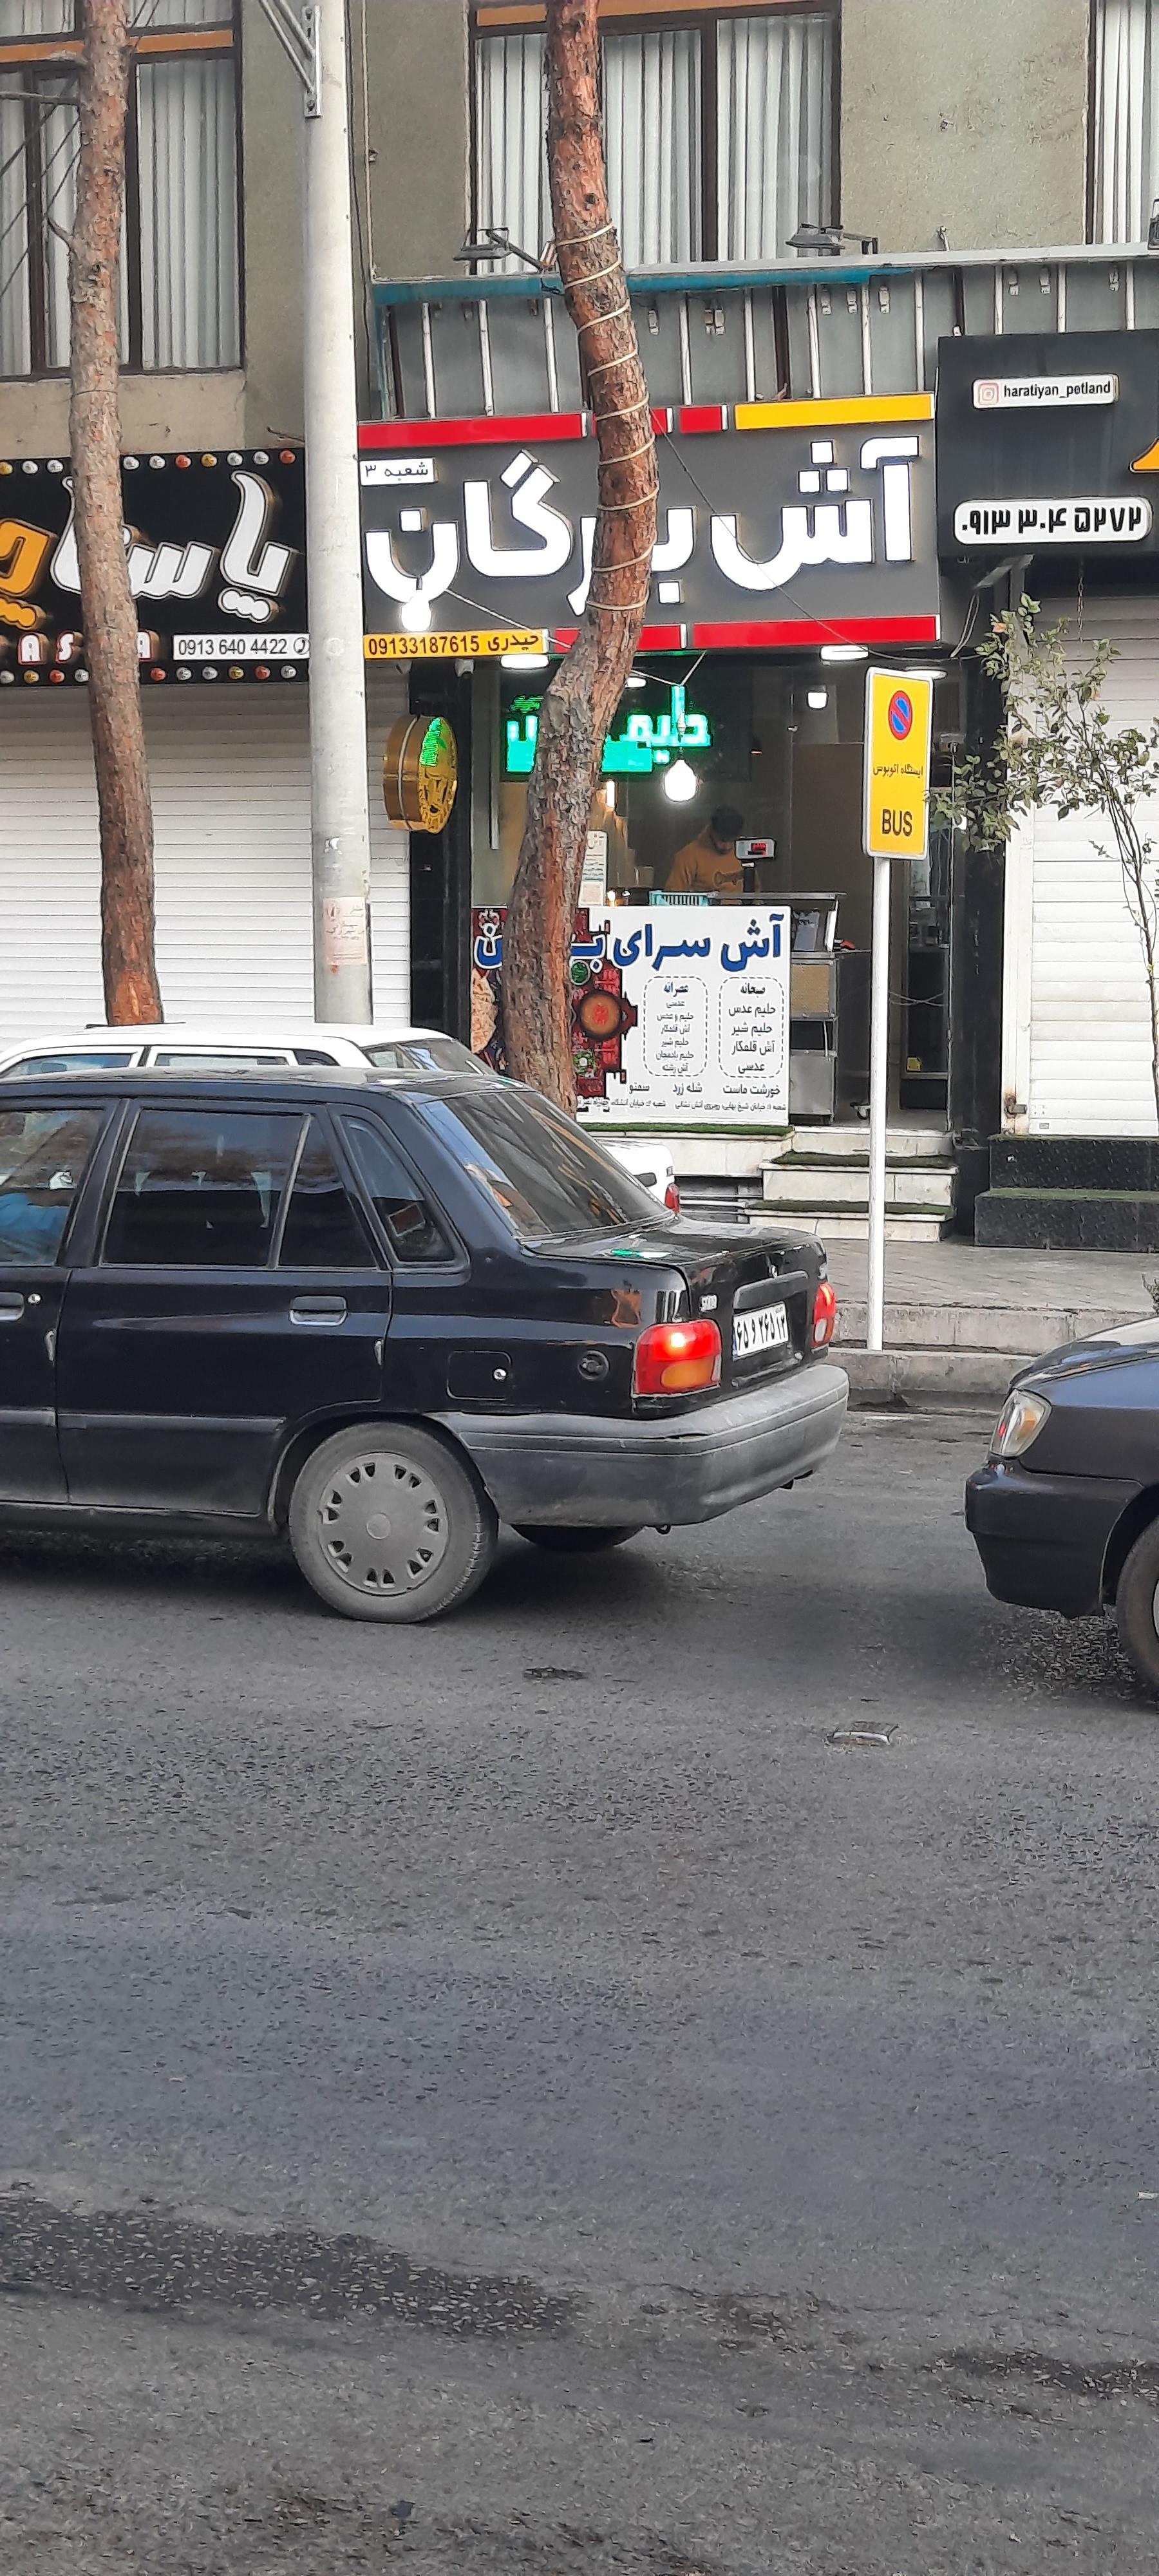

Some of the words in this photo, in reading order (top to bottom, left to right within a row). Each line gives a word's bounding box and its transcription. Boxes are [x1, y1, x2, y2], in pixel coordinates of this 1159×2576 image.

[364, 464, 377, 478] ۳
[384, 462, 429, 481] شعبه
[710, 435, 919, 591] آش
[365, 450, 694, 616] برگان
[178, 638, 214, 656] 0913
[218, 638, 246, 655] 640
[250, 637, 288, 655] 4422
[368, 635, 480, 656] 09133187615
[487, 634, 540, 651] حیدری
[619, 685, 711, 765] حلیم
[872, 762, 899, 778] اتوبوس
[881, 809, 912, 837] BUS
[613, 923, 711, 971] سرای
[720, 913, 784, 972] آش
[728, 1005, 753, 1017] عدس
[755, 1003, 777, 1018] حلیم
[731, 1021, 749, 1036] شیر
[751, 1022, 773, 1037] حلیم
[731, 1040, 757, 1056] قلمکار
[759, 1040, 775, 1056] آش
[738, 1063, 766, 1074] عدسی
[629, 1082, 650, 1095] سمنو
[672, 1083, 684, 1095] زرد
[686, 1082, 702, 1093] شله
[722, 1084, 748, 1095] ماست
[749, 1084, 781, 1098] خورشت
